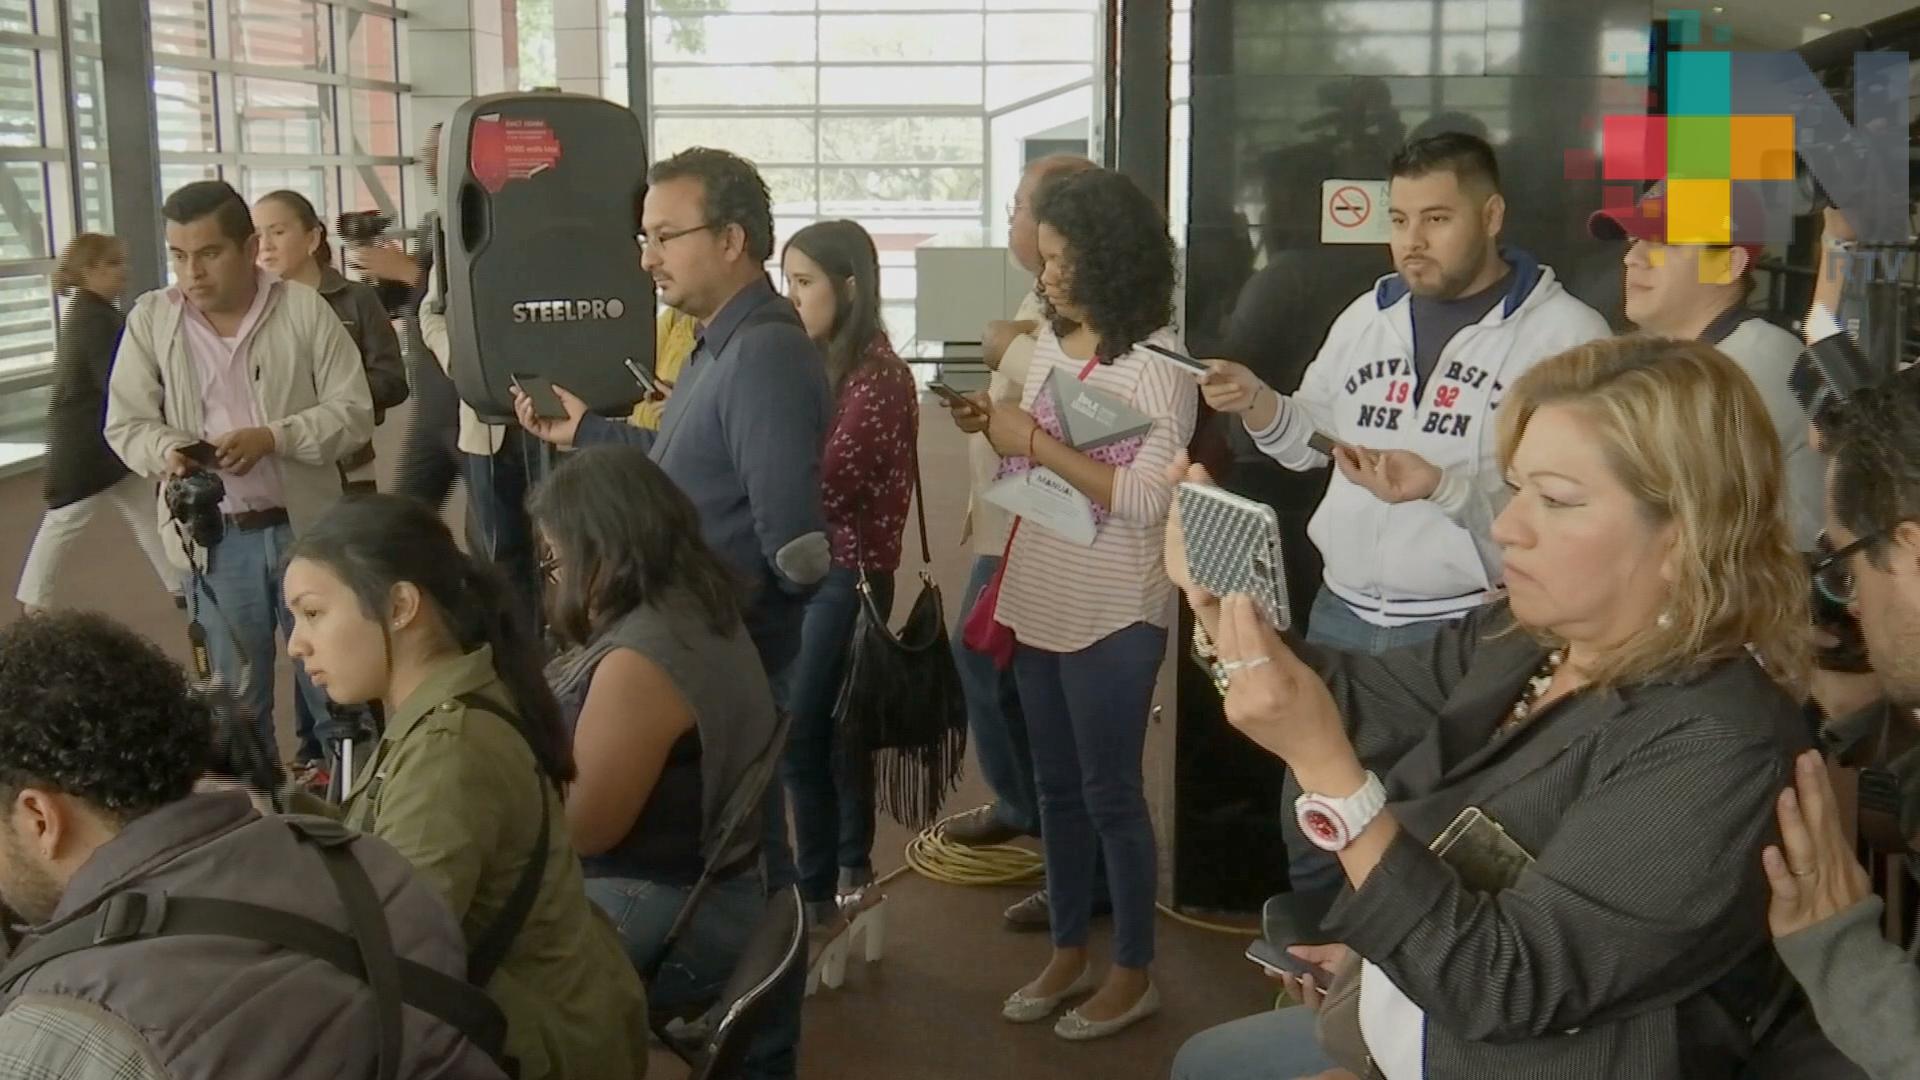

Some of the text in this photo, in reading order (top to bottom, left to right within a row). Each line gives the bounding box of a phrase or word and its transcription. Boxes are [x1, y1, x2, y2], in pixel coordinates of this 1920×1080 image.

[512, 299, 625, 323] STEELPRO
[1357, 405, 1471, 437] NSK BCN
[1036, 474, 1073, 497] MANUAL
